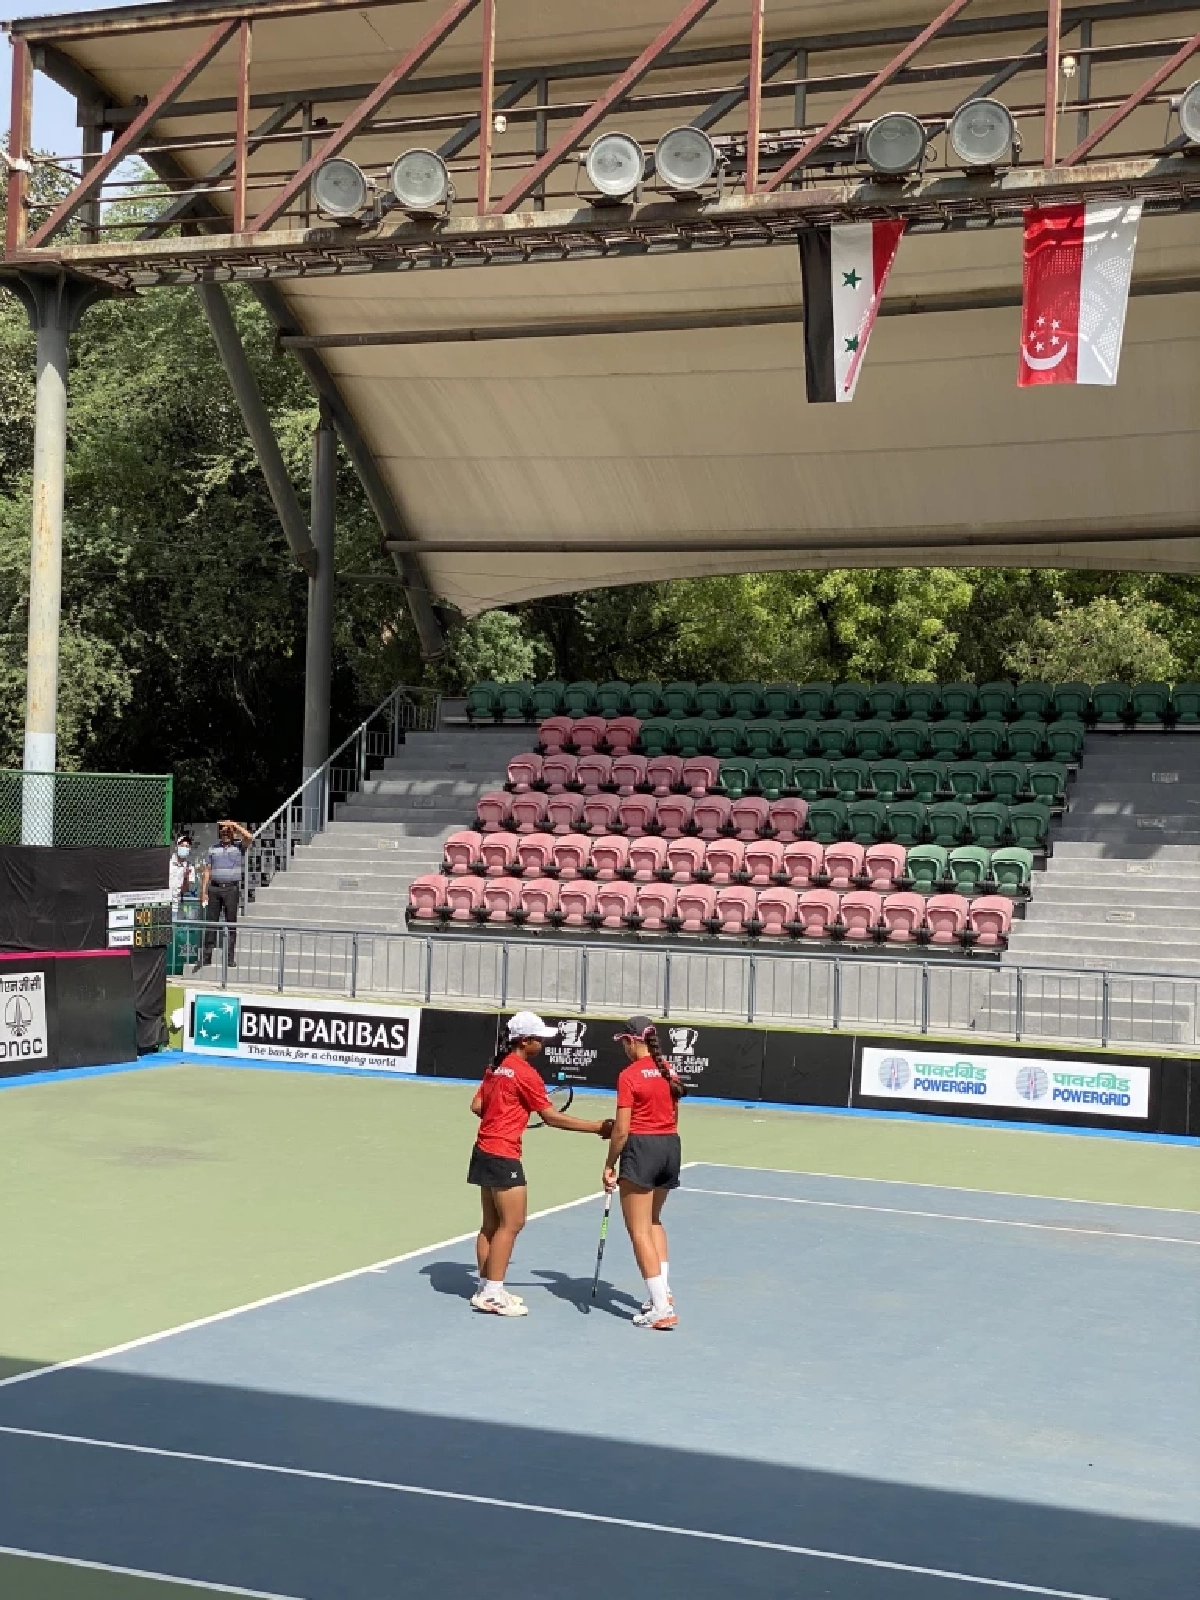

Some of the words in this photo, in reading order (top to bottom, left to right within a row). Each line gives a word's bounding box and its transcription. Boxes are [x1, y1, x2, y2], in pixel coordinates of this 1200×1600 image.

[241, 1011, 292, 1040] BNP
[299, 1016, 406, 1049] PARIBAS
[248, 1045, 266, 1056] The
[269, 1046, 292, 1057] bank
[292, 1049, 309, 1060] for
[319, 1052, 367, 1067] changing
[368, 1057, 396, 1067] world
[545, 1047, 572, 1056] BILLIE
[573, 1048, 598, 1059] JEAN
[550, 1055, 572, 1065] KING
[573, 1057, 593, 1067] CUP
[684, 1056, 709, 1066] JEAN
[684, 1065, 703, 1074] CUP
[914, 1077, 987, 1095] POWERGRID
[1053, 1089, 1131, 1107] POWERGRID
